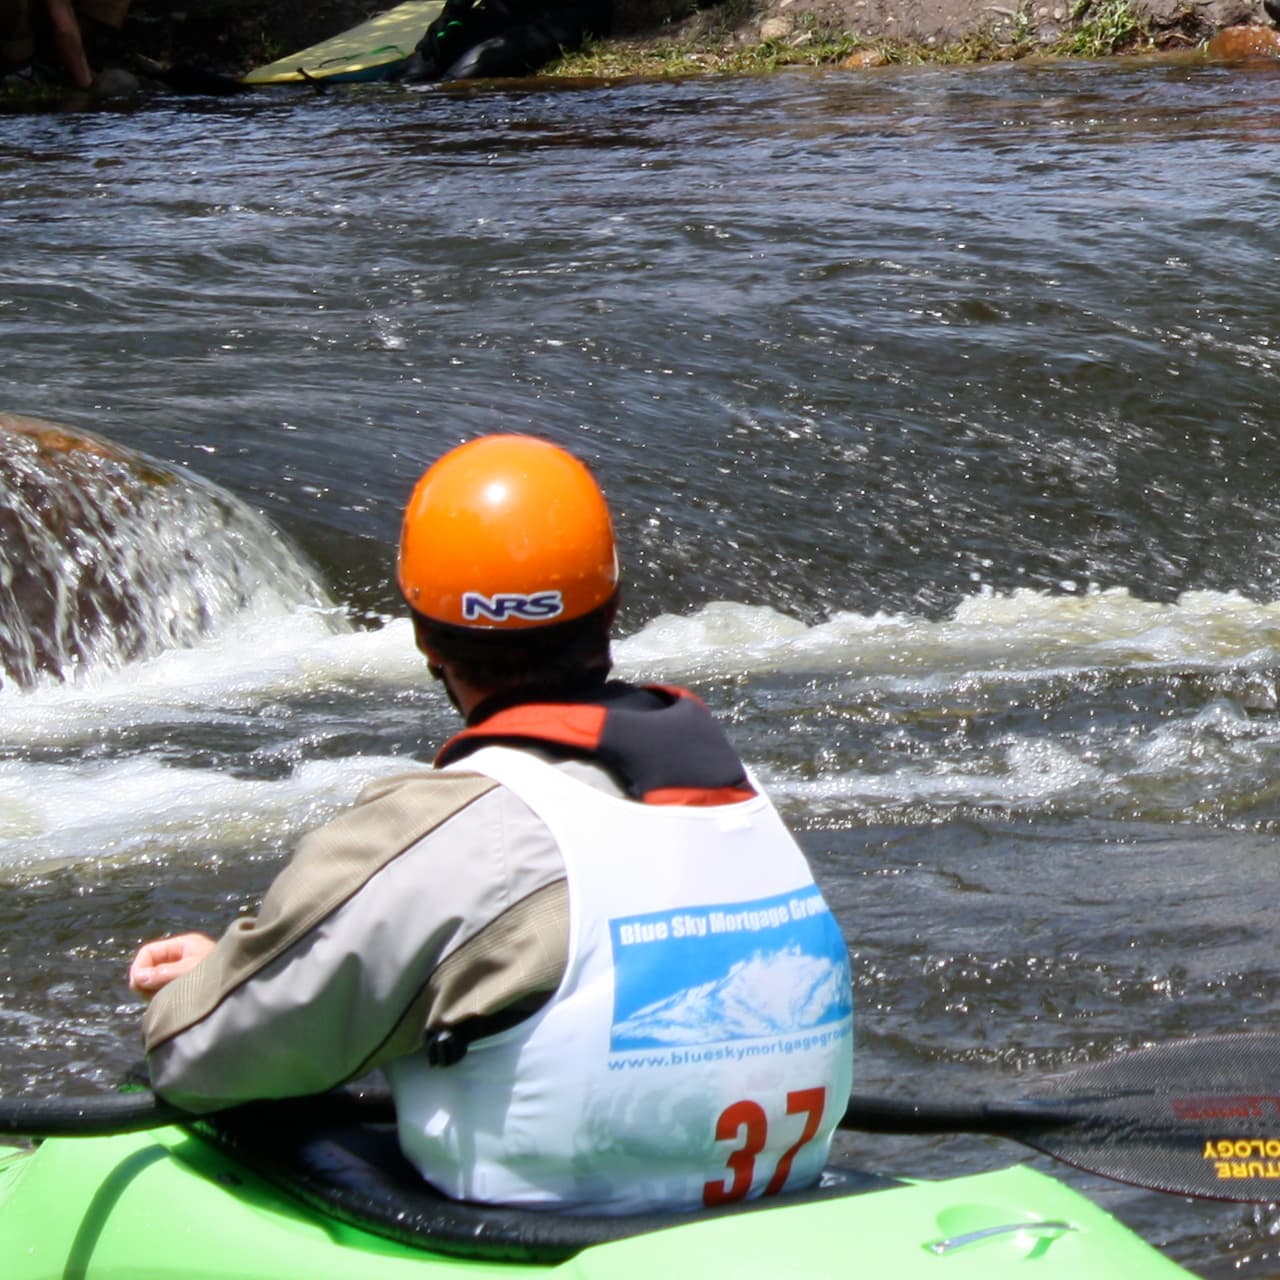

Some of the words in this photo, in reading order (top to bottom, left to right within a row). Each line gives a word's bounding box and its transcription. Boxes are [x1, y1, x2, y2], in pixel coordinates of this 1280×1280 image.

[463, 590, 563, 621] NRS
[619, 922, 669, 946] Blue
[671, 914, 707, 938] Sky
[709, 904, 789, 933] Mortgage
[702, 1086, 826, 1207] 37
